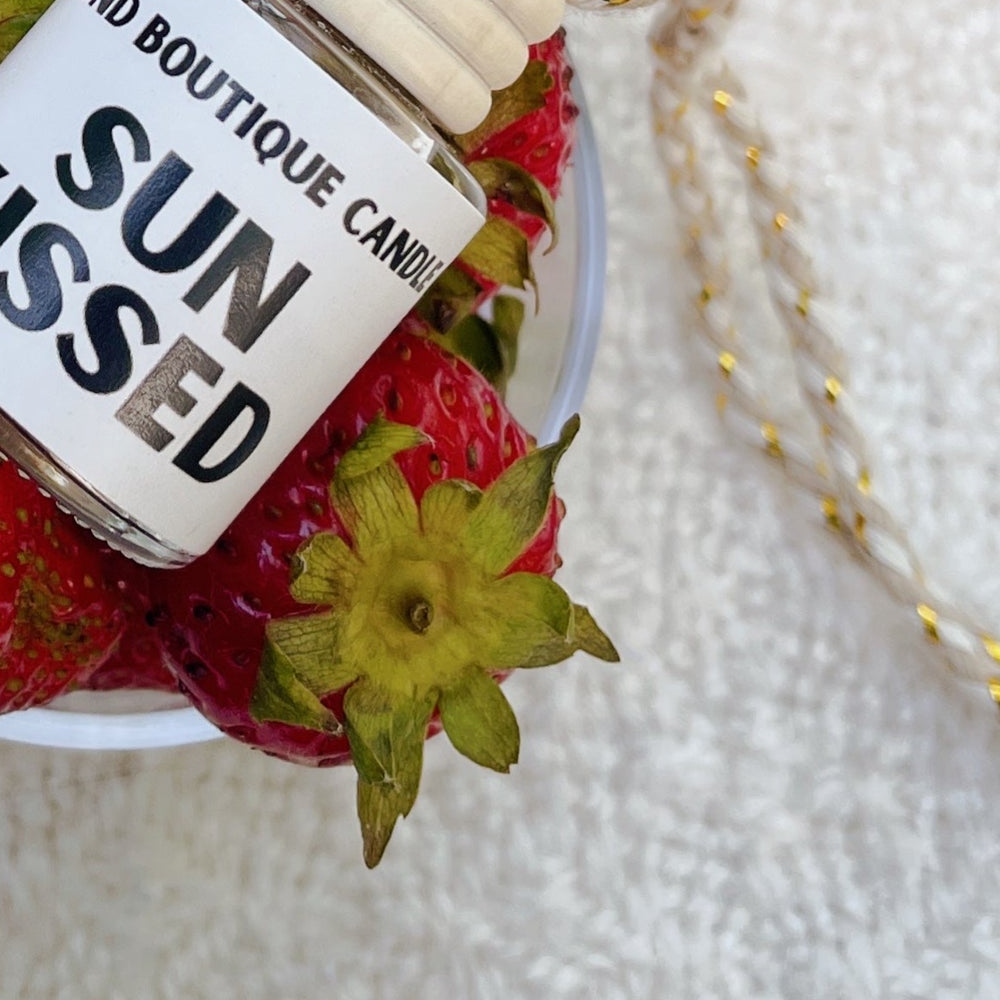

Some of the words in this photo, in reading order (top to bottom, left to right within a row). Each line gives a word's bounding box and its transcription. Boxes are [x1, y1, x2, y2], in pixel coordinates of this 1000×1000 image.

[55, 105, 312, 354] SUN
[133, 11, 347, 209] BOUTIQUE
[341, 196, 445, 293] CANDLE
